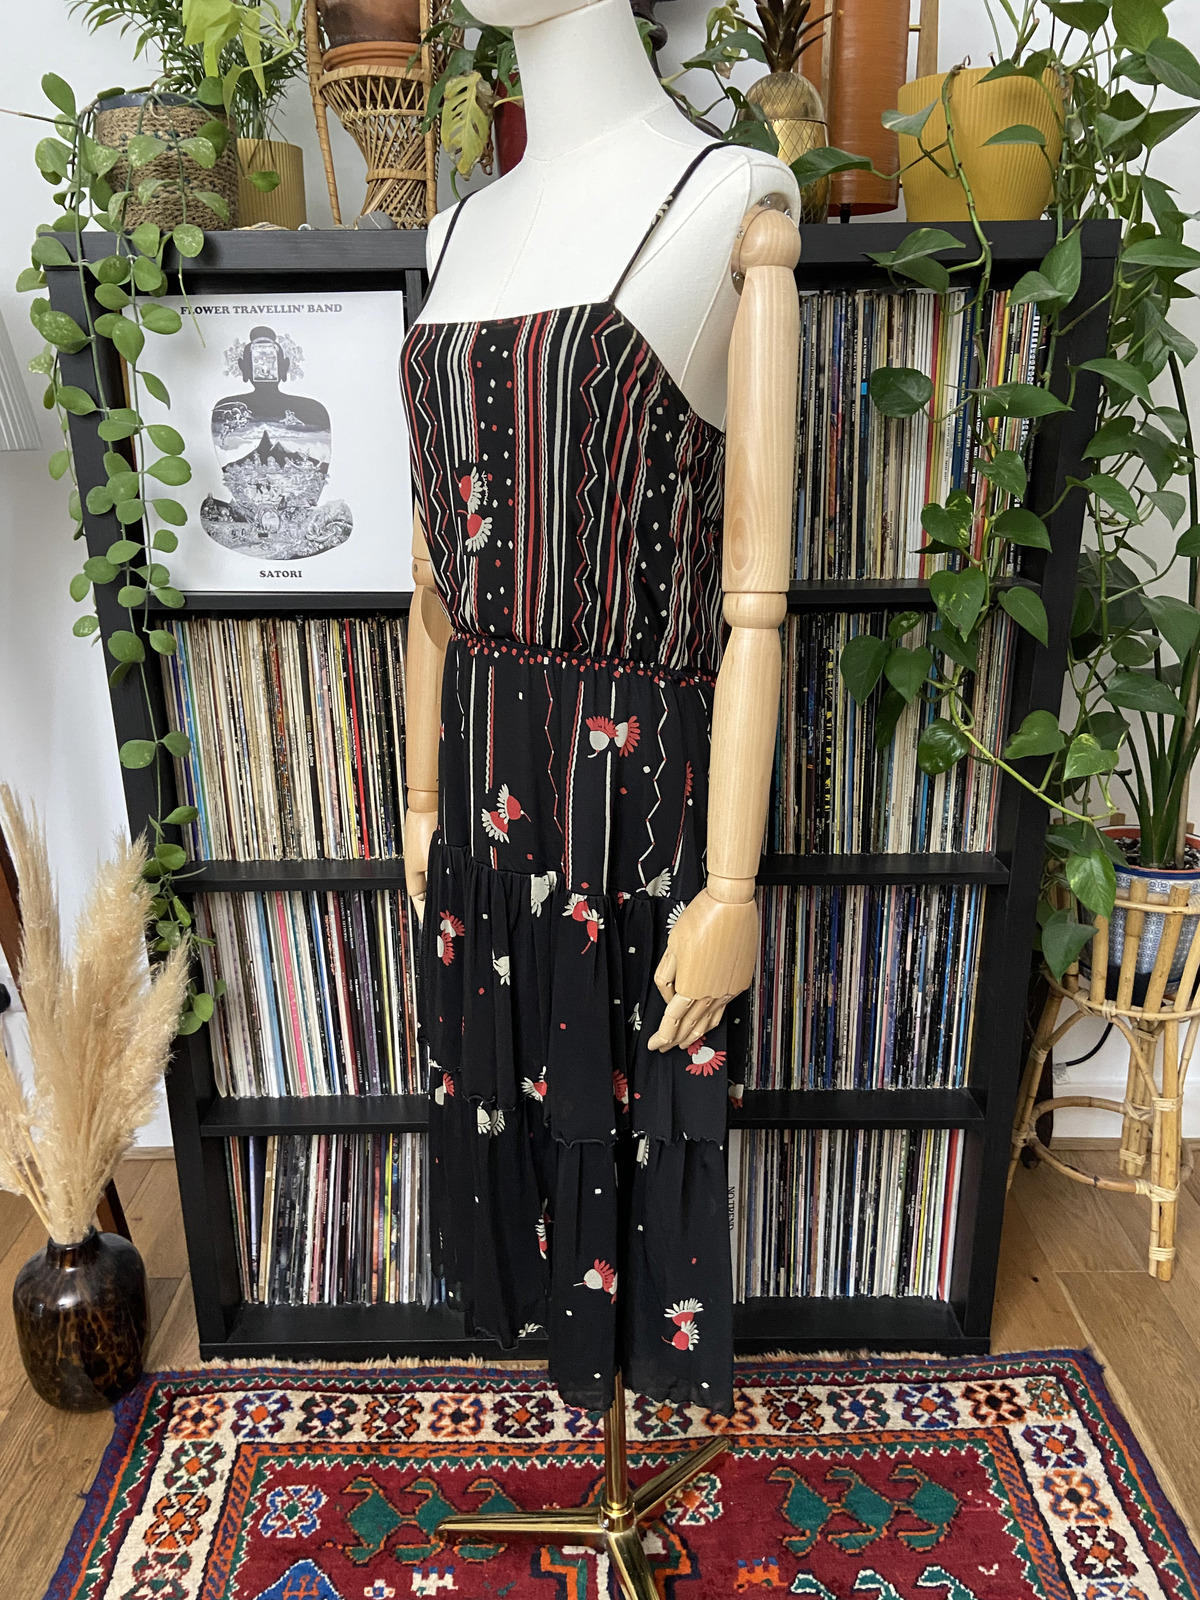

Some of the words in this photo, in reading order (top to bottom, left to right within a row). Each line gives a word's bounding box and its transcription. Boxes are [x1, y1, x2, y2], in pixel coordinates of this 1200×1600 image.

[232, 304, 305, 314] TRAVELLIN'
[307, 303, 343, 313] BAND
[259, 570, 302, 578] SATORI
